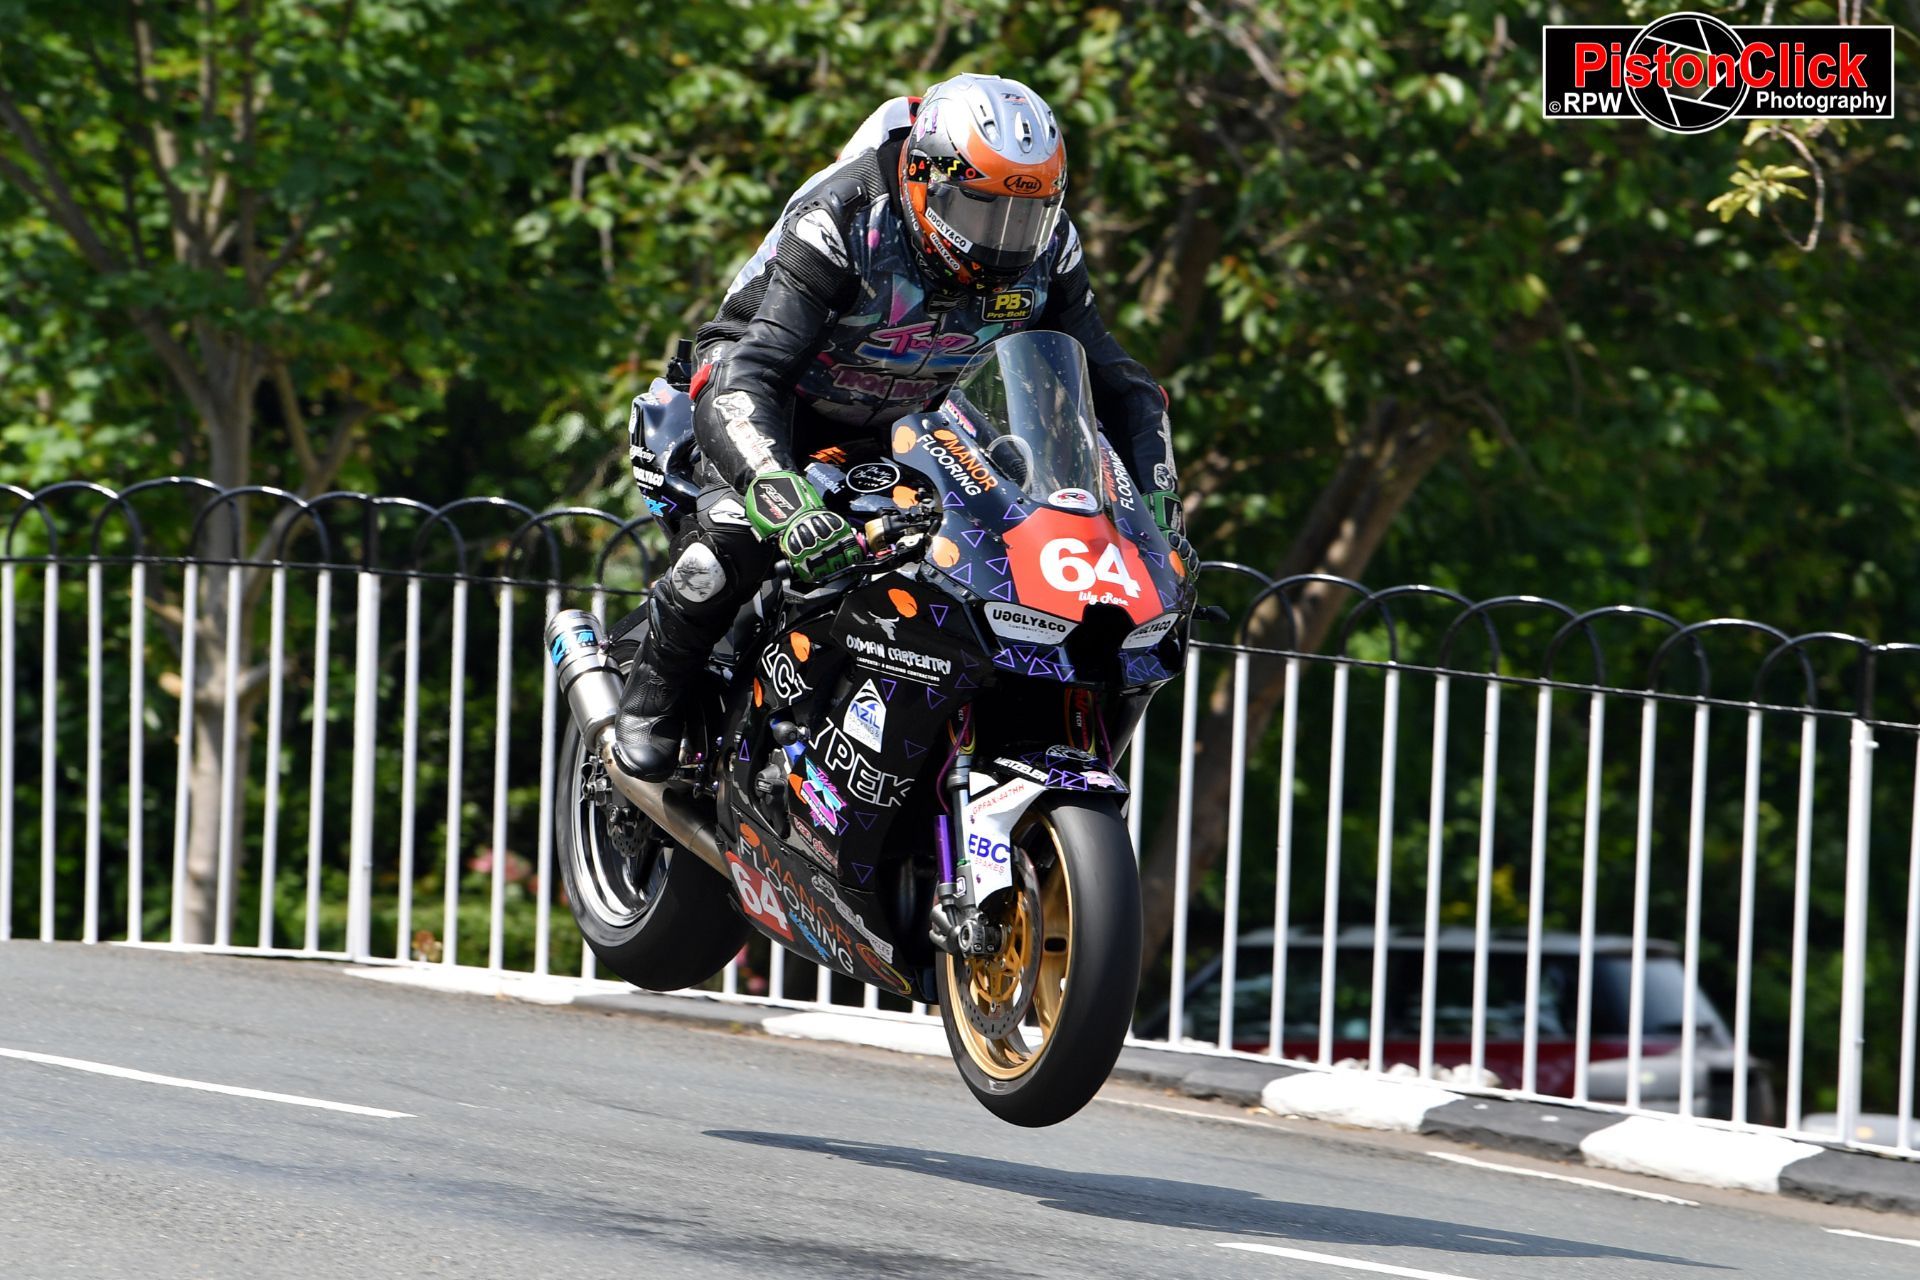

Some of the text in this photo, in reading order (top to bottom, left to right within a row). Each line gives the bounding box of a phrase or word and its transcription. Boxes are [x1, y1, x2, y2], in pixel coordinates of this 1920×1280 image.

[1007, 176, 1038, 190] Arai
[986, 310, 1027, 319] Pro-Bolt
[994, 293, 1021, 311] PB
[916, 433, 982, 496] FLOORING
[944, 439, 999, 492] MANOR
[1109, 450, 1136, 511] FLOORING
[759, 483, 796, 511] RST
[1039, 537, 1142, 598] 64
[846, 634, 952, 675] OXMAN CARPENTRY
[993, 756, 1050, 782] METZELER
[968, 833, 1010, 865] EBC
[731, 861, 788, 931] 64
[738, 836, 854, 974] FLOORING
[761, 844, 855, 958] MANOR
